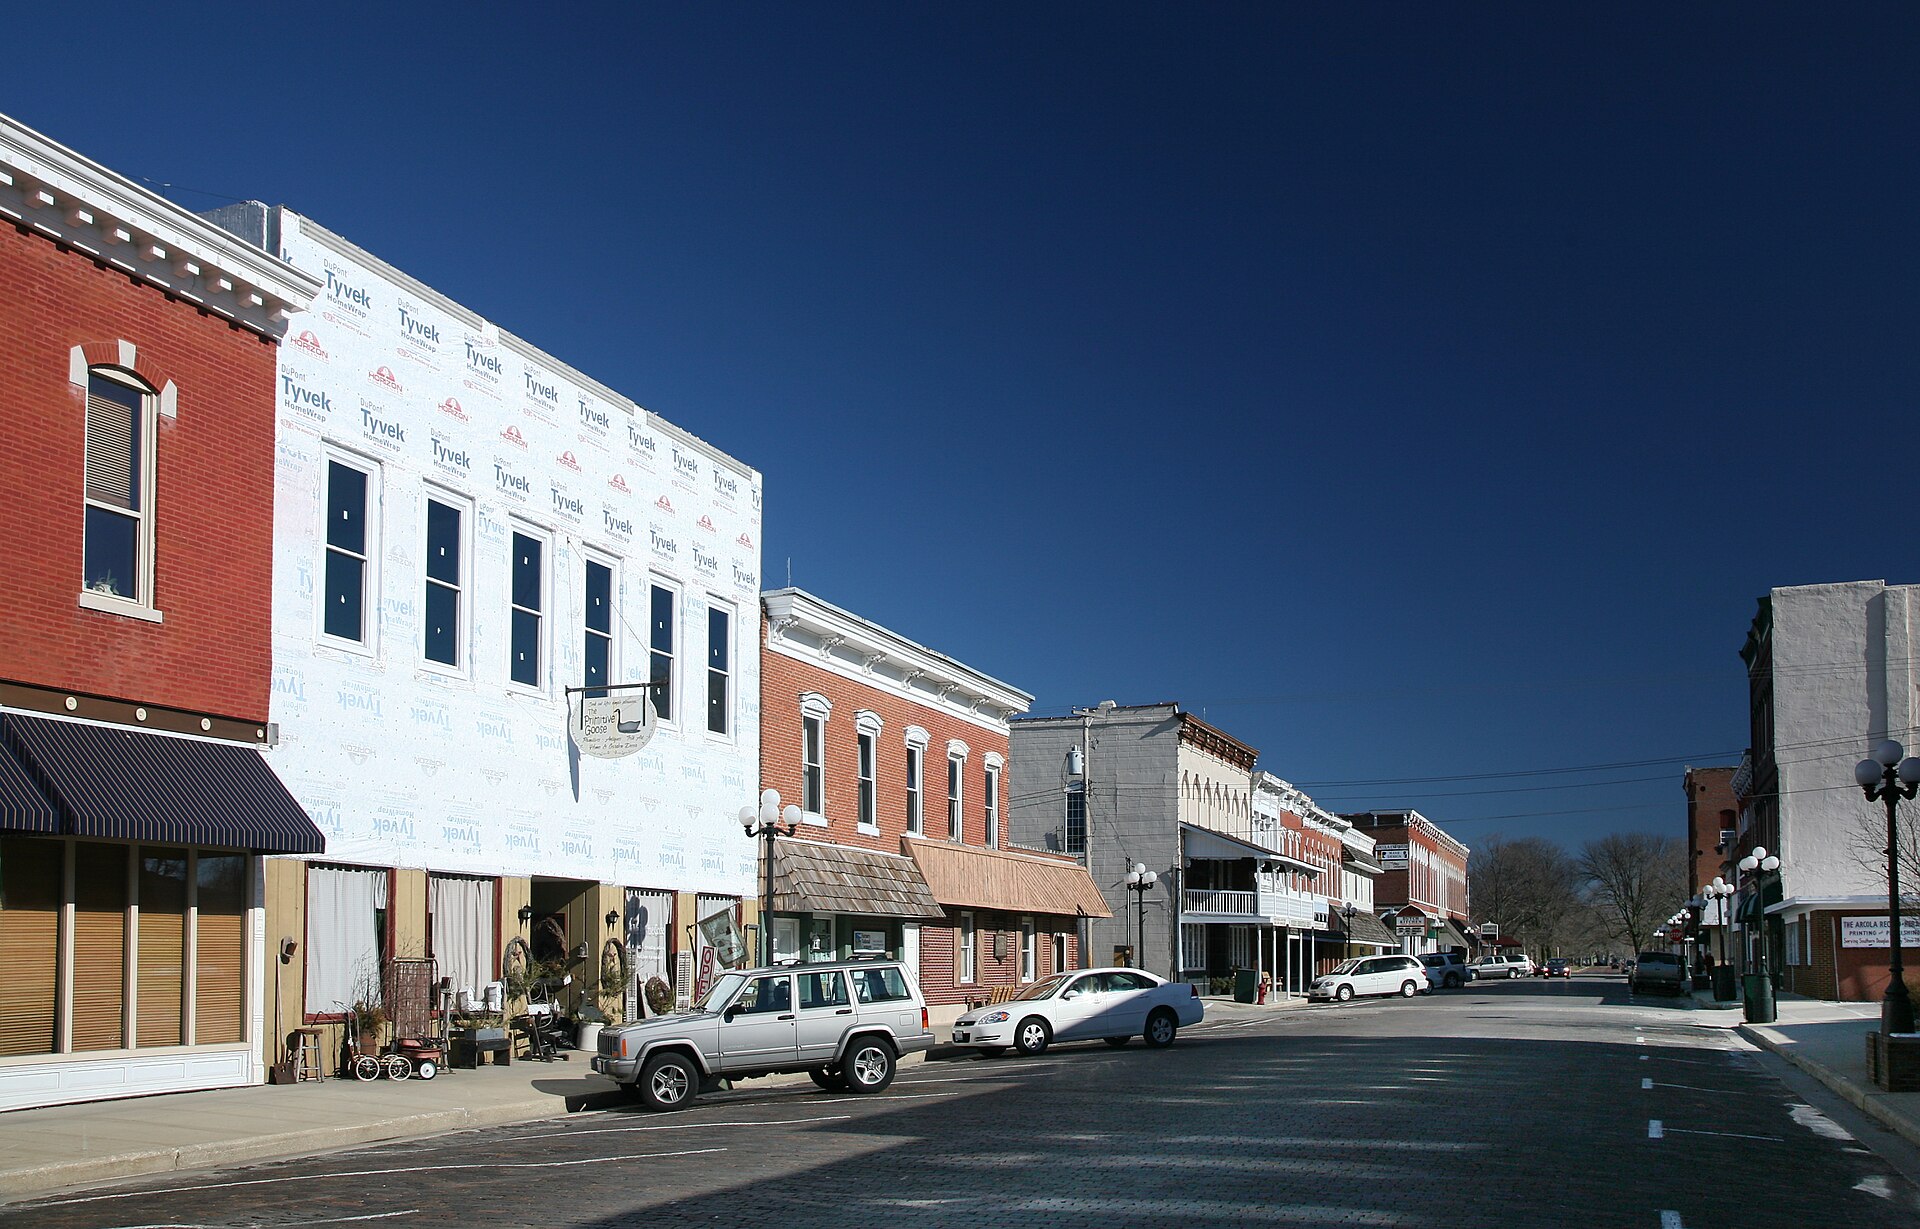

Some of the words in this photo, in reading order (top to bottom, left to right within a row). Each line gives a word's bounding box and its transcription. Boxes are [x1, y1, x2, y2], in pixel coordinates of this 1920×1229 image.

[324, 259, 347, 278] DuPont
[324, 269, 371, 310] Tyvek
[327, 293, 367, 318] HomeWrap
[398, 307, 441, 345] Tyvek
[290, 336, 329, 359] HORIZON
[401, 329, 436, 353] HomeWrap
[465, 341, 503, 376] Tyvek
[281, 363, 306, 382] DuPont
[368, 371, 402, 392] HORIZON
[467, 362, 499, 384] HomeWrap
[282, 374, 332, 413] Tyvek
[524, 372, 559, 404] Tyvek
[285, 398, 327, 422] HomeWrap
[360, 397, 383, 414] DuPont
[437, 402, 468, 422] HORIZON
[578, 400, 610, 429] Tyvek
[361, 407, 406, 443] Tyvek
[363, 430, 401, 452] HomeWrap
[500, 431, 528, 448] HORIZON
[627, 425, 656, 453] Tyvek
[431, 437, 471, 470] Tyvek
[556, 456, 582, 472] HORIZON
[672, 448, 698, 474] Tyvek
[433, 458, 467, 478] HomeWrap
[494, 464, 530, 494] Tyvek
[713, 469, 738, 494] Tyvek
[496, 484, 527, 502] HomeWrap
[551, 488, 584, 516] Tyvek
[553, 507, 581, 524] HomeWrap
[603, 510, 633, 536] Tyvek
[650, 529, 677, 554] Tyvek
[693, 548, 718, 571] Tyvek
[732, 564, 756, 586] Tyvek
[341, 680, 380, 696] HomeWrap
[336, 690, 384, 718] Tyvek
[740, 697, 758, 714] Tyve
[410, 708, 452, 732] Tyvek
[584, 715, 616, 726] Primitive
[585, 724, 608, 736] Goose
[476, 722, 514, 744] Tyvek
[340, 744, 376, 755] HORIZON
[638, 756, 665, 776] Tyvek
[682, 766, 708, 784] Tyvek
[722, 774, 746, 792] Tyvek
[300, 796, 341, 810] HomeWrap
[378, 806, 414, 818] HomeWrap
[306, 808, 344, 832] Tyve
[372, 818, 416, 840] Tyvek
[442, 826, 481, 848] Tyvek
[504, 834, 541, 854] Tyvek
[562, 841, 593, 860] Tyvek
[612, 848, 642, 864] Tyvek
[658, 852, 687, 870] Tyvek
[701, 858, 726, 874] Tyvek
[740, 862, 757, 876] yvek
[699, 950, 712, 999] OPE
